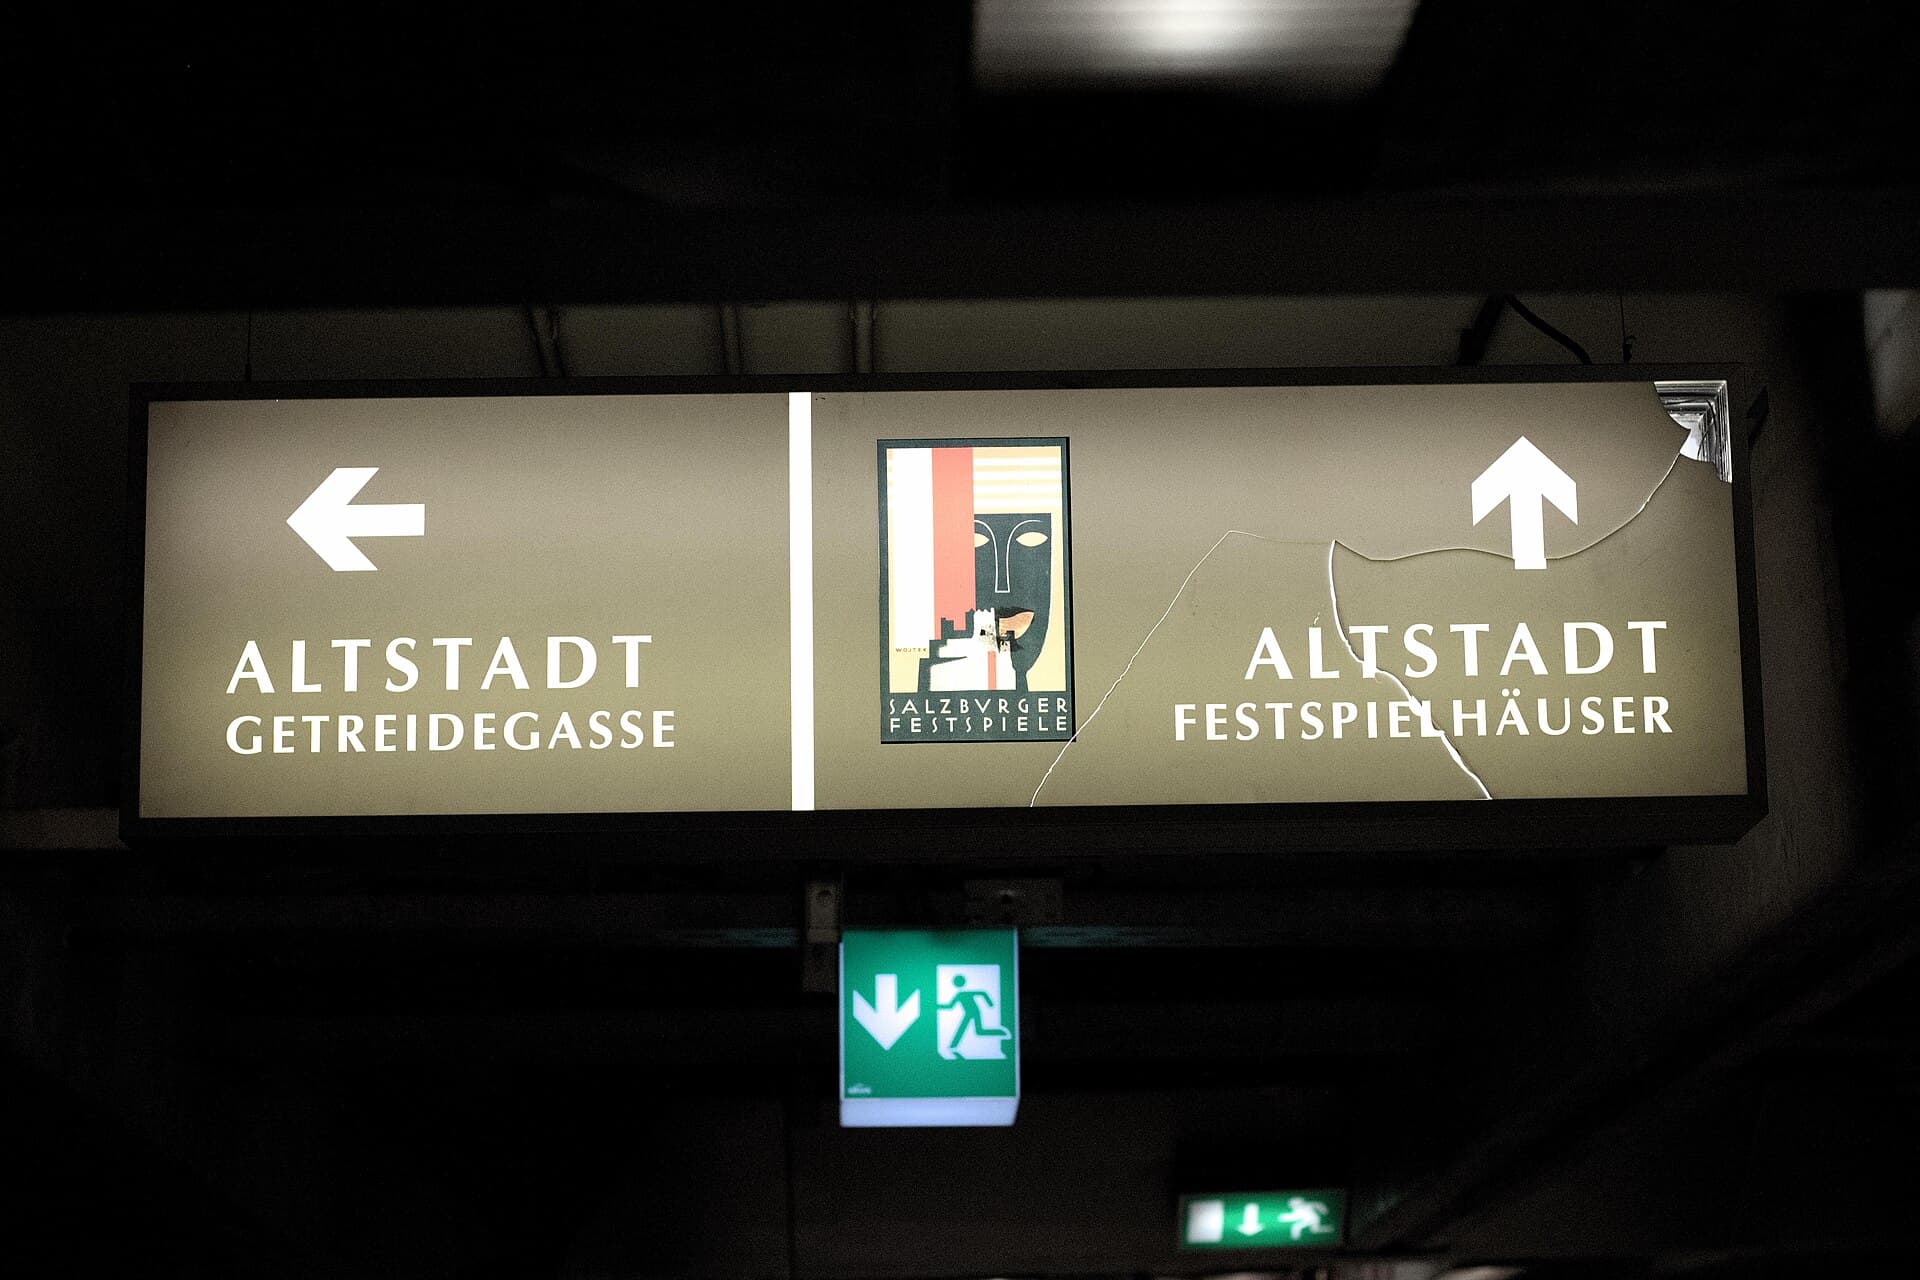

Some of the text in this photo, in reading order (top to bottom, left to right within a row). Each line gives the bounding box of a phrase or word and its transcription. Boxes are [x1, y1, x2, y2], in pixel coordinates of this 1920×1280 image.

[226, 635, 652, 694] ALTSTADT
[1244, 621, 1667, 680] ALTSTADT
[225, 710, 675, 755] GETREIDEGASSE
[889, 716, 1067, 733] FESTSPIELE
[1174, 688, 1673, 741] FESTSPIELHÄUSER
